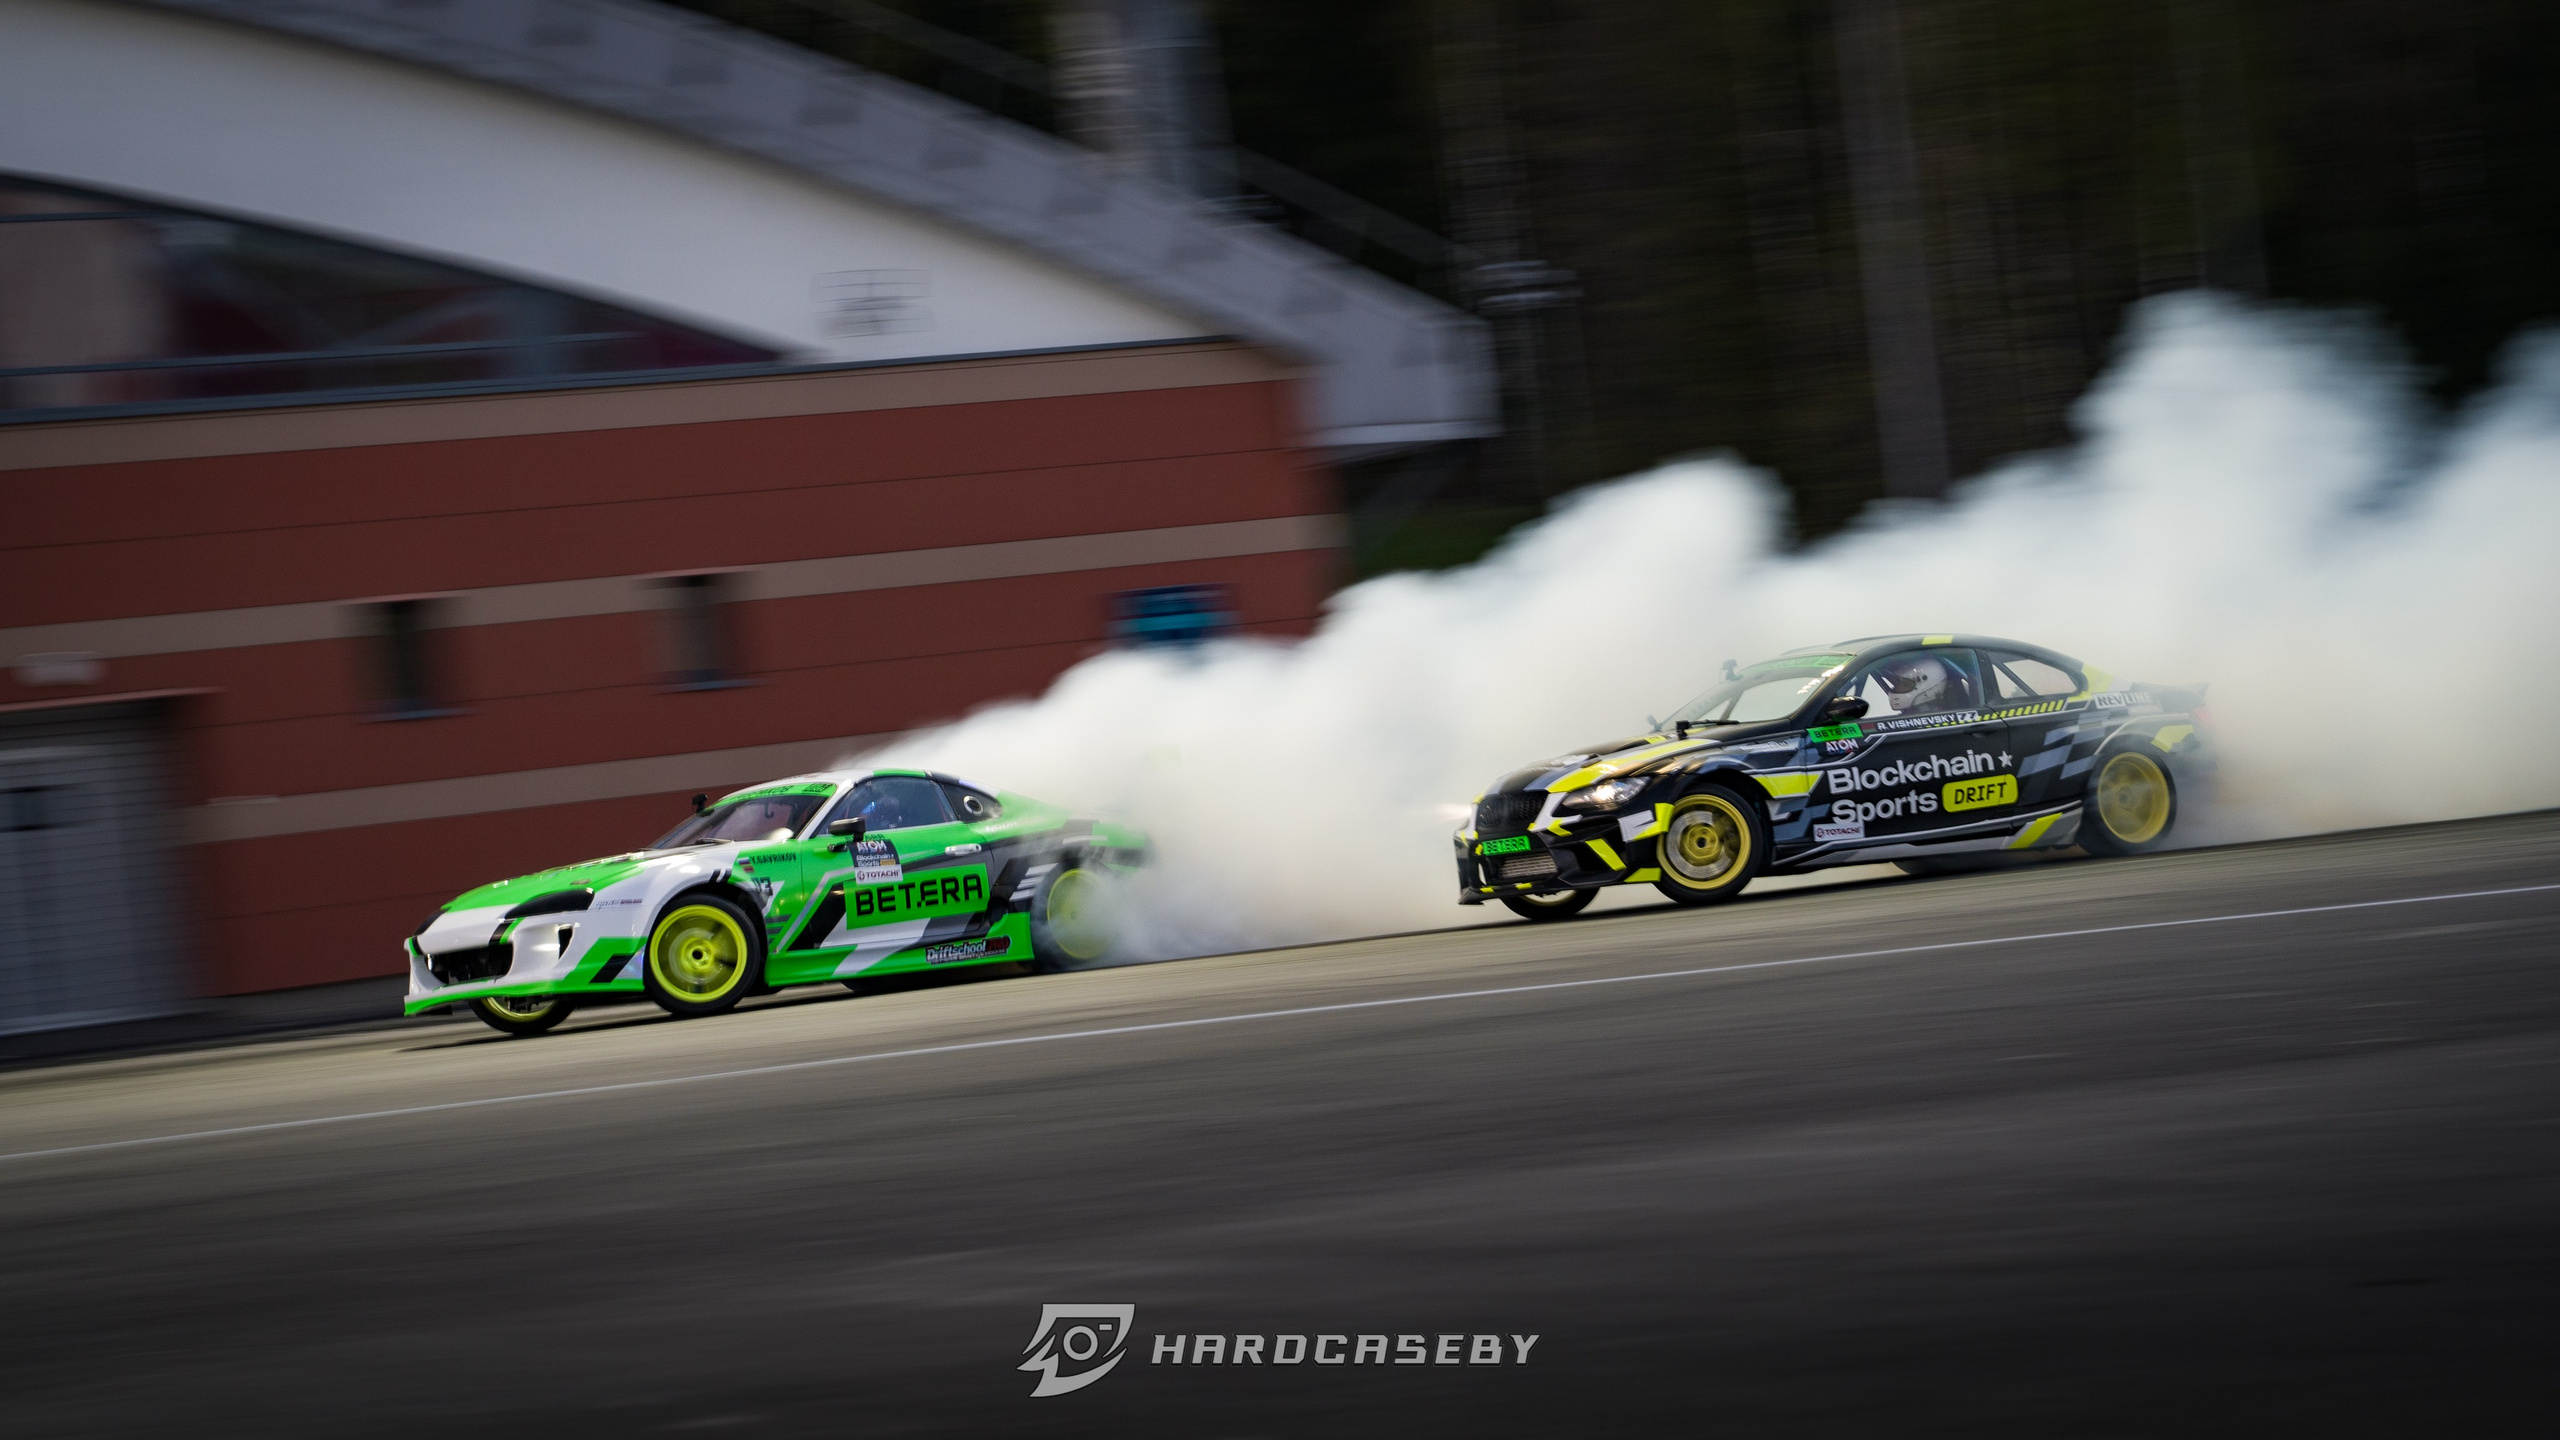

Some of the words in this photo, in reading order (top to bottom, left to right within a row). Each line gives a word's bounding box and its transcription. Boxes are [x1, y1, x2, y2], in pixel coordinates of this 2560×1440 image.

[1827, 749, 1995, 795] Blockchain
[1831, 789, 1939, 824] Sports
[1954, 782, 2007, 805] DRIFT
[856, 840, 887, 853] ATOM
[866, 870, 899, 878] TOTACHI
